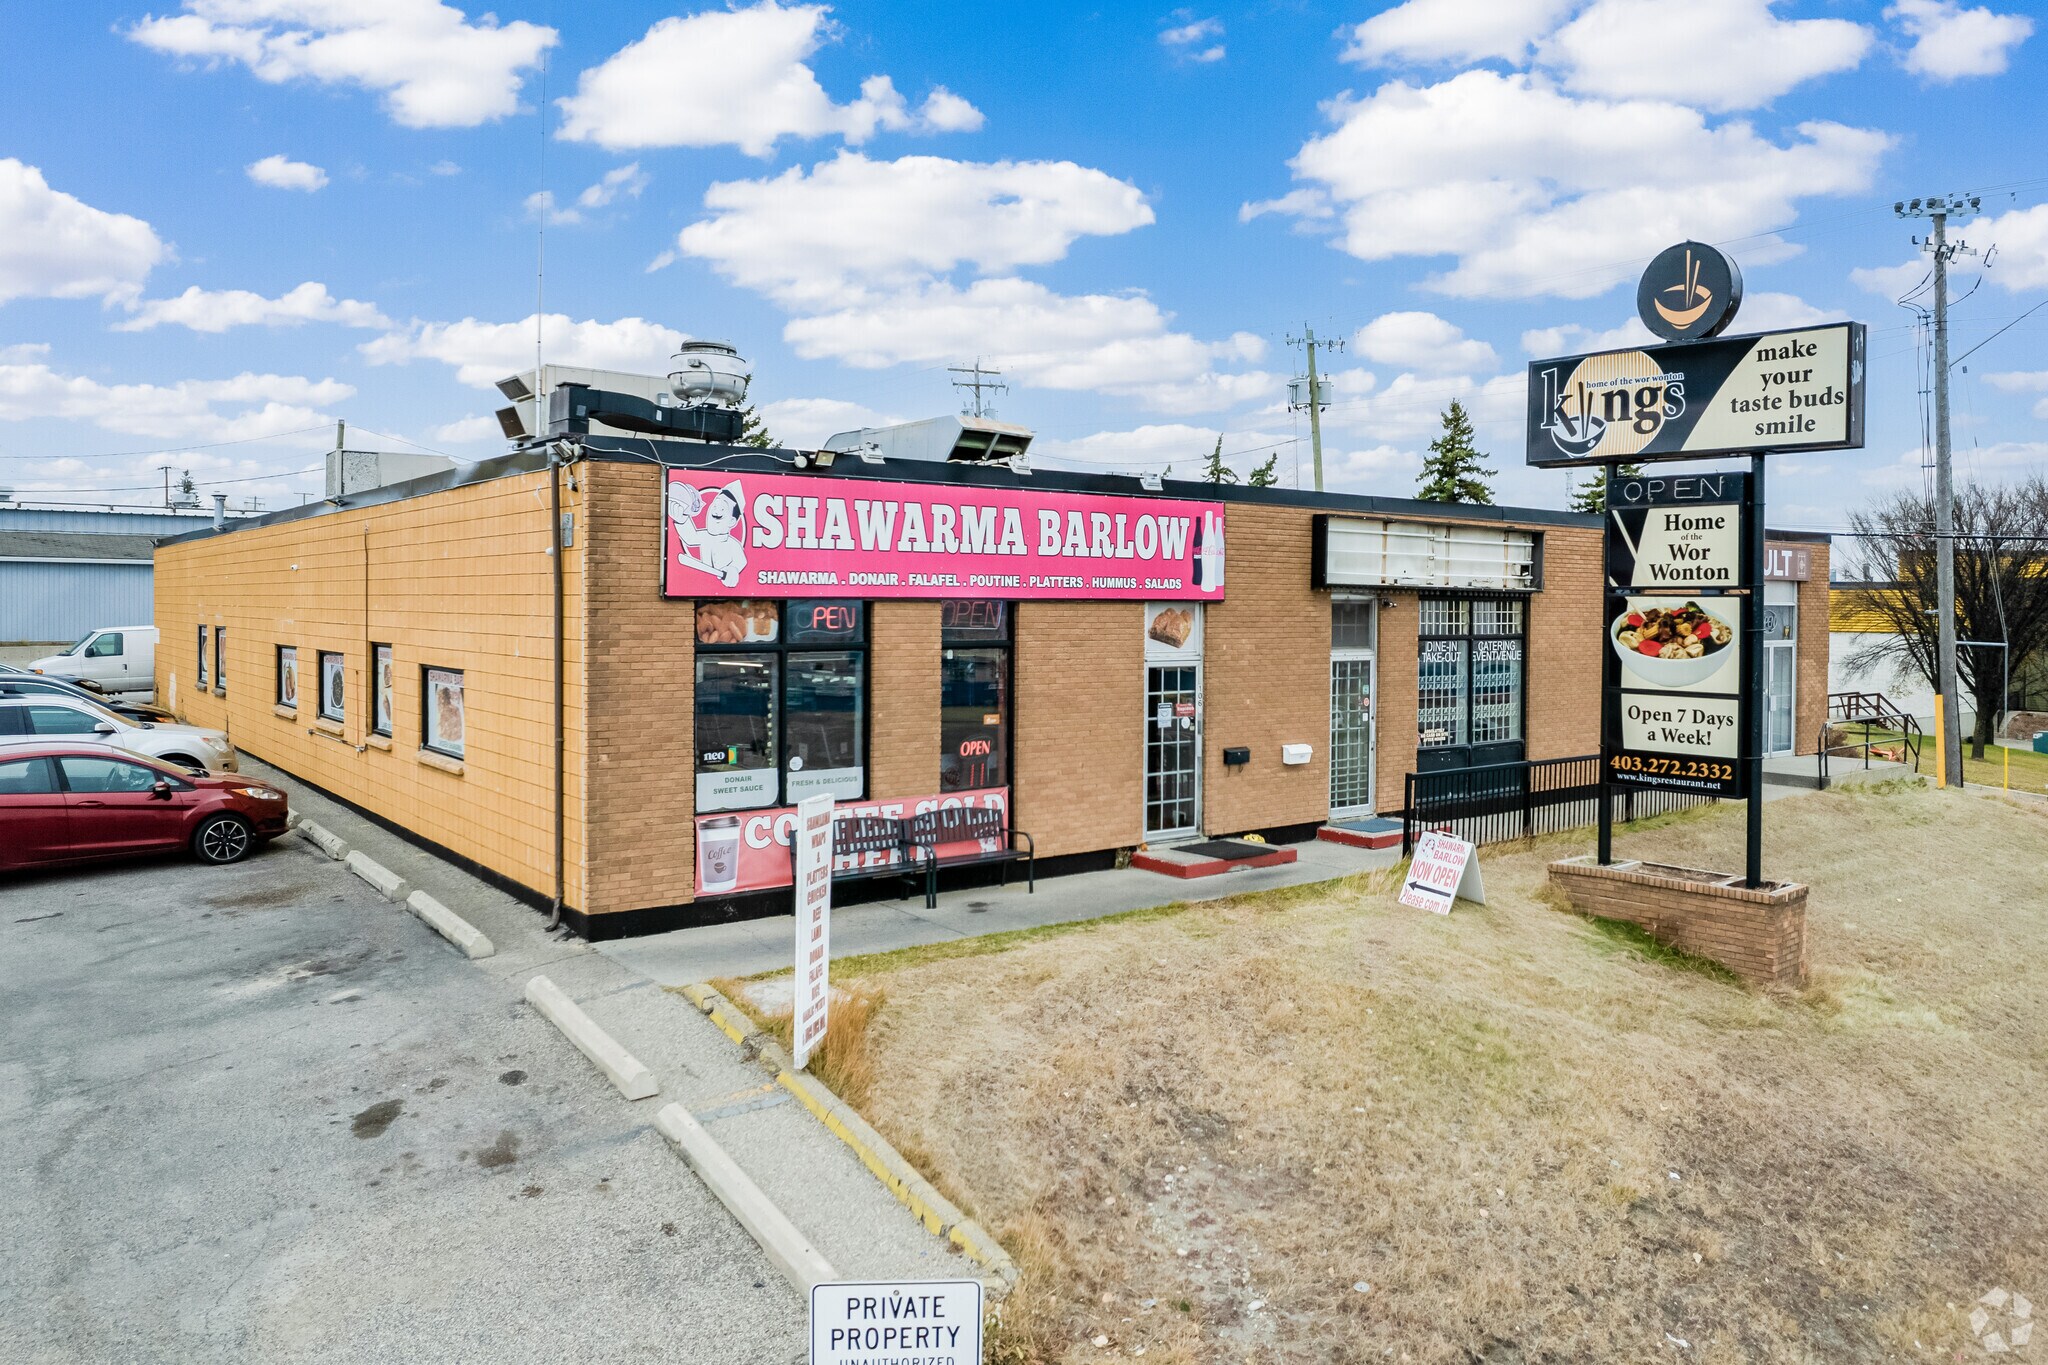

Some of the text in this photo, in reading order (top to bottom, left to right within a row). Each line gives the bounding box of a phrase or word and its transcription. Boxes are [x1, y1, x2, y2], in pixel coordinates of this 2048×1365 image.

[1756, 339, 1818, 363] make
[1586, 372, 1684, 389] home of the wor wonton
[1760, 365, 1813, 392] your
[1730, 386, 1845, 414] taste buds
[1754, 414, 1816, 437] smile
[1624, 475, 1725, 502] OPEN
[752, 492, 1191, 561] SHAWARMA BARLOW
[1664, 513, 1725, 532] Home
[1680, 532, 1703, 541] of the
[1668, 543, 1711, 561] Wor
[757, 571, 1182, 590] SHAWARMA DONAIR FALAFEL POUTINE PLATTERS HUMMUS SALADS
[1649, 563, 1730, 581] Wonton
[942, 600, 1000, 628] OPEN
[1426, 641, 1458, 652] DINE-IN
[1478, 641, 1516, 651] CATERING
[1422, 651, 1462, 663] TAKE-OUT
[1627, 705, 1734, 730] Open 7 Days
[1647, 727, 1712, 746] a Week!
[703, 750, 726, 761] neo
[960, 740, 991, 757] OPEN
[1610, 755, 1733, 780] 403.272.2332
[724, 775, 752, 784] DONAIR
[791, 779, 814, 787] FRESH
[822, 775, 859, 785] DELICIOUS
[1616, 772, 1721, 790] www.kingsrestaurant.net
[713, 784, 764, 795] SWEET SAUCE
[708, 846, 732, 861] Coffee
[1433, 849, 1466, 867] BARLOW
[1410, 859, 1461, 889] NOW OPEN
[846, 1296, 946, 1320] PRIVATE
[831, 1325, 961, 1351] PROPERTY
